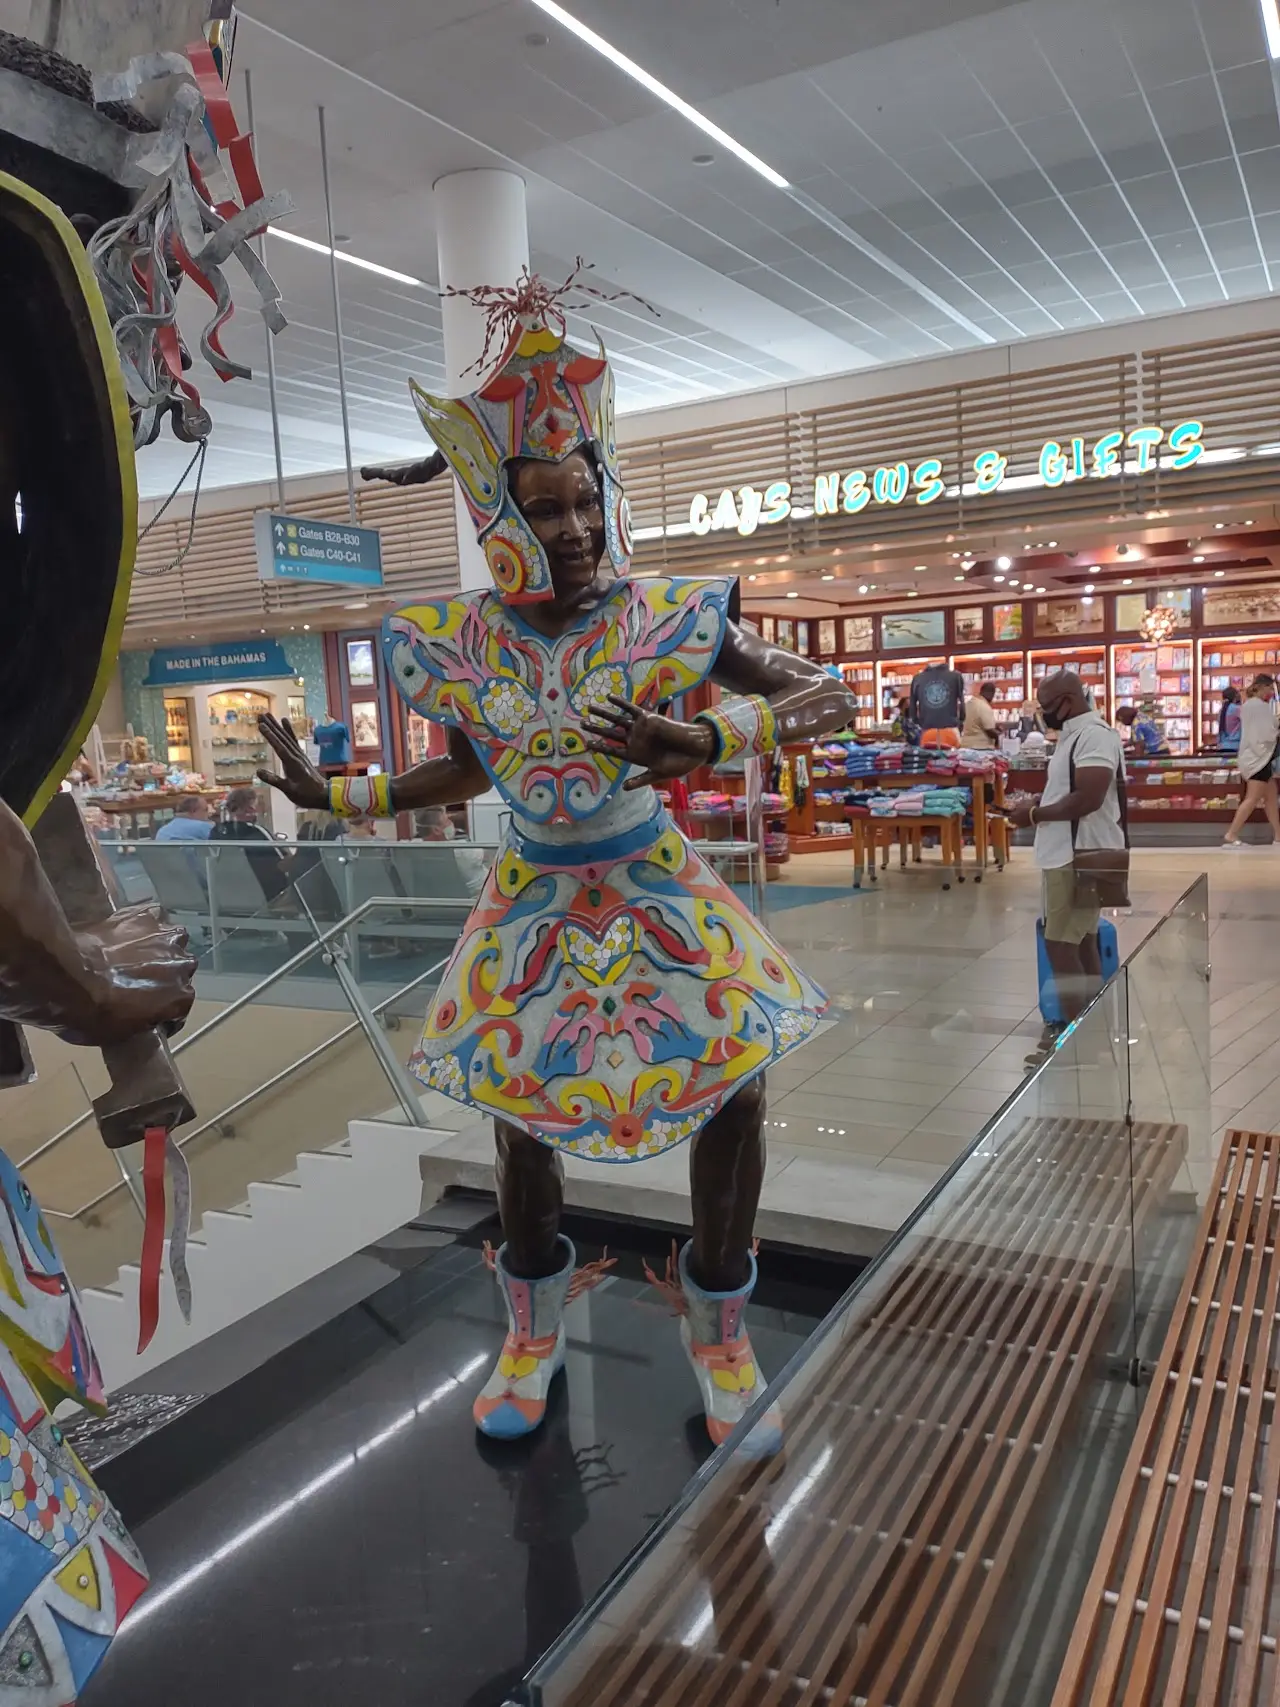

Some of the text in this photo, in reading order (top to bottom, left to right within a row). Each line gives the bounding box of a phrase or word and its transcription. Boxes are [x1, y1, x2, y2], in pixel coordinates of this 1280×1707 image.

[689, 420, 1205, 536] CAYS NEWS & GIFTS
[298, 526, 323, 540] Gates
[300, 545, 361, 562] Gates C40-C41
[166, 652, 267, 670] MADE IN THE BAHAMAS
